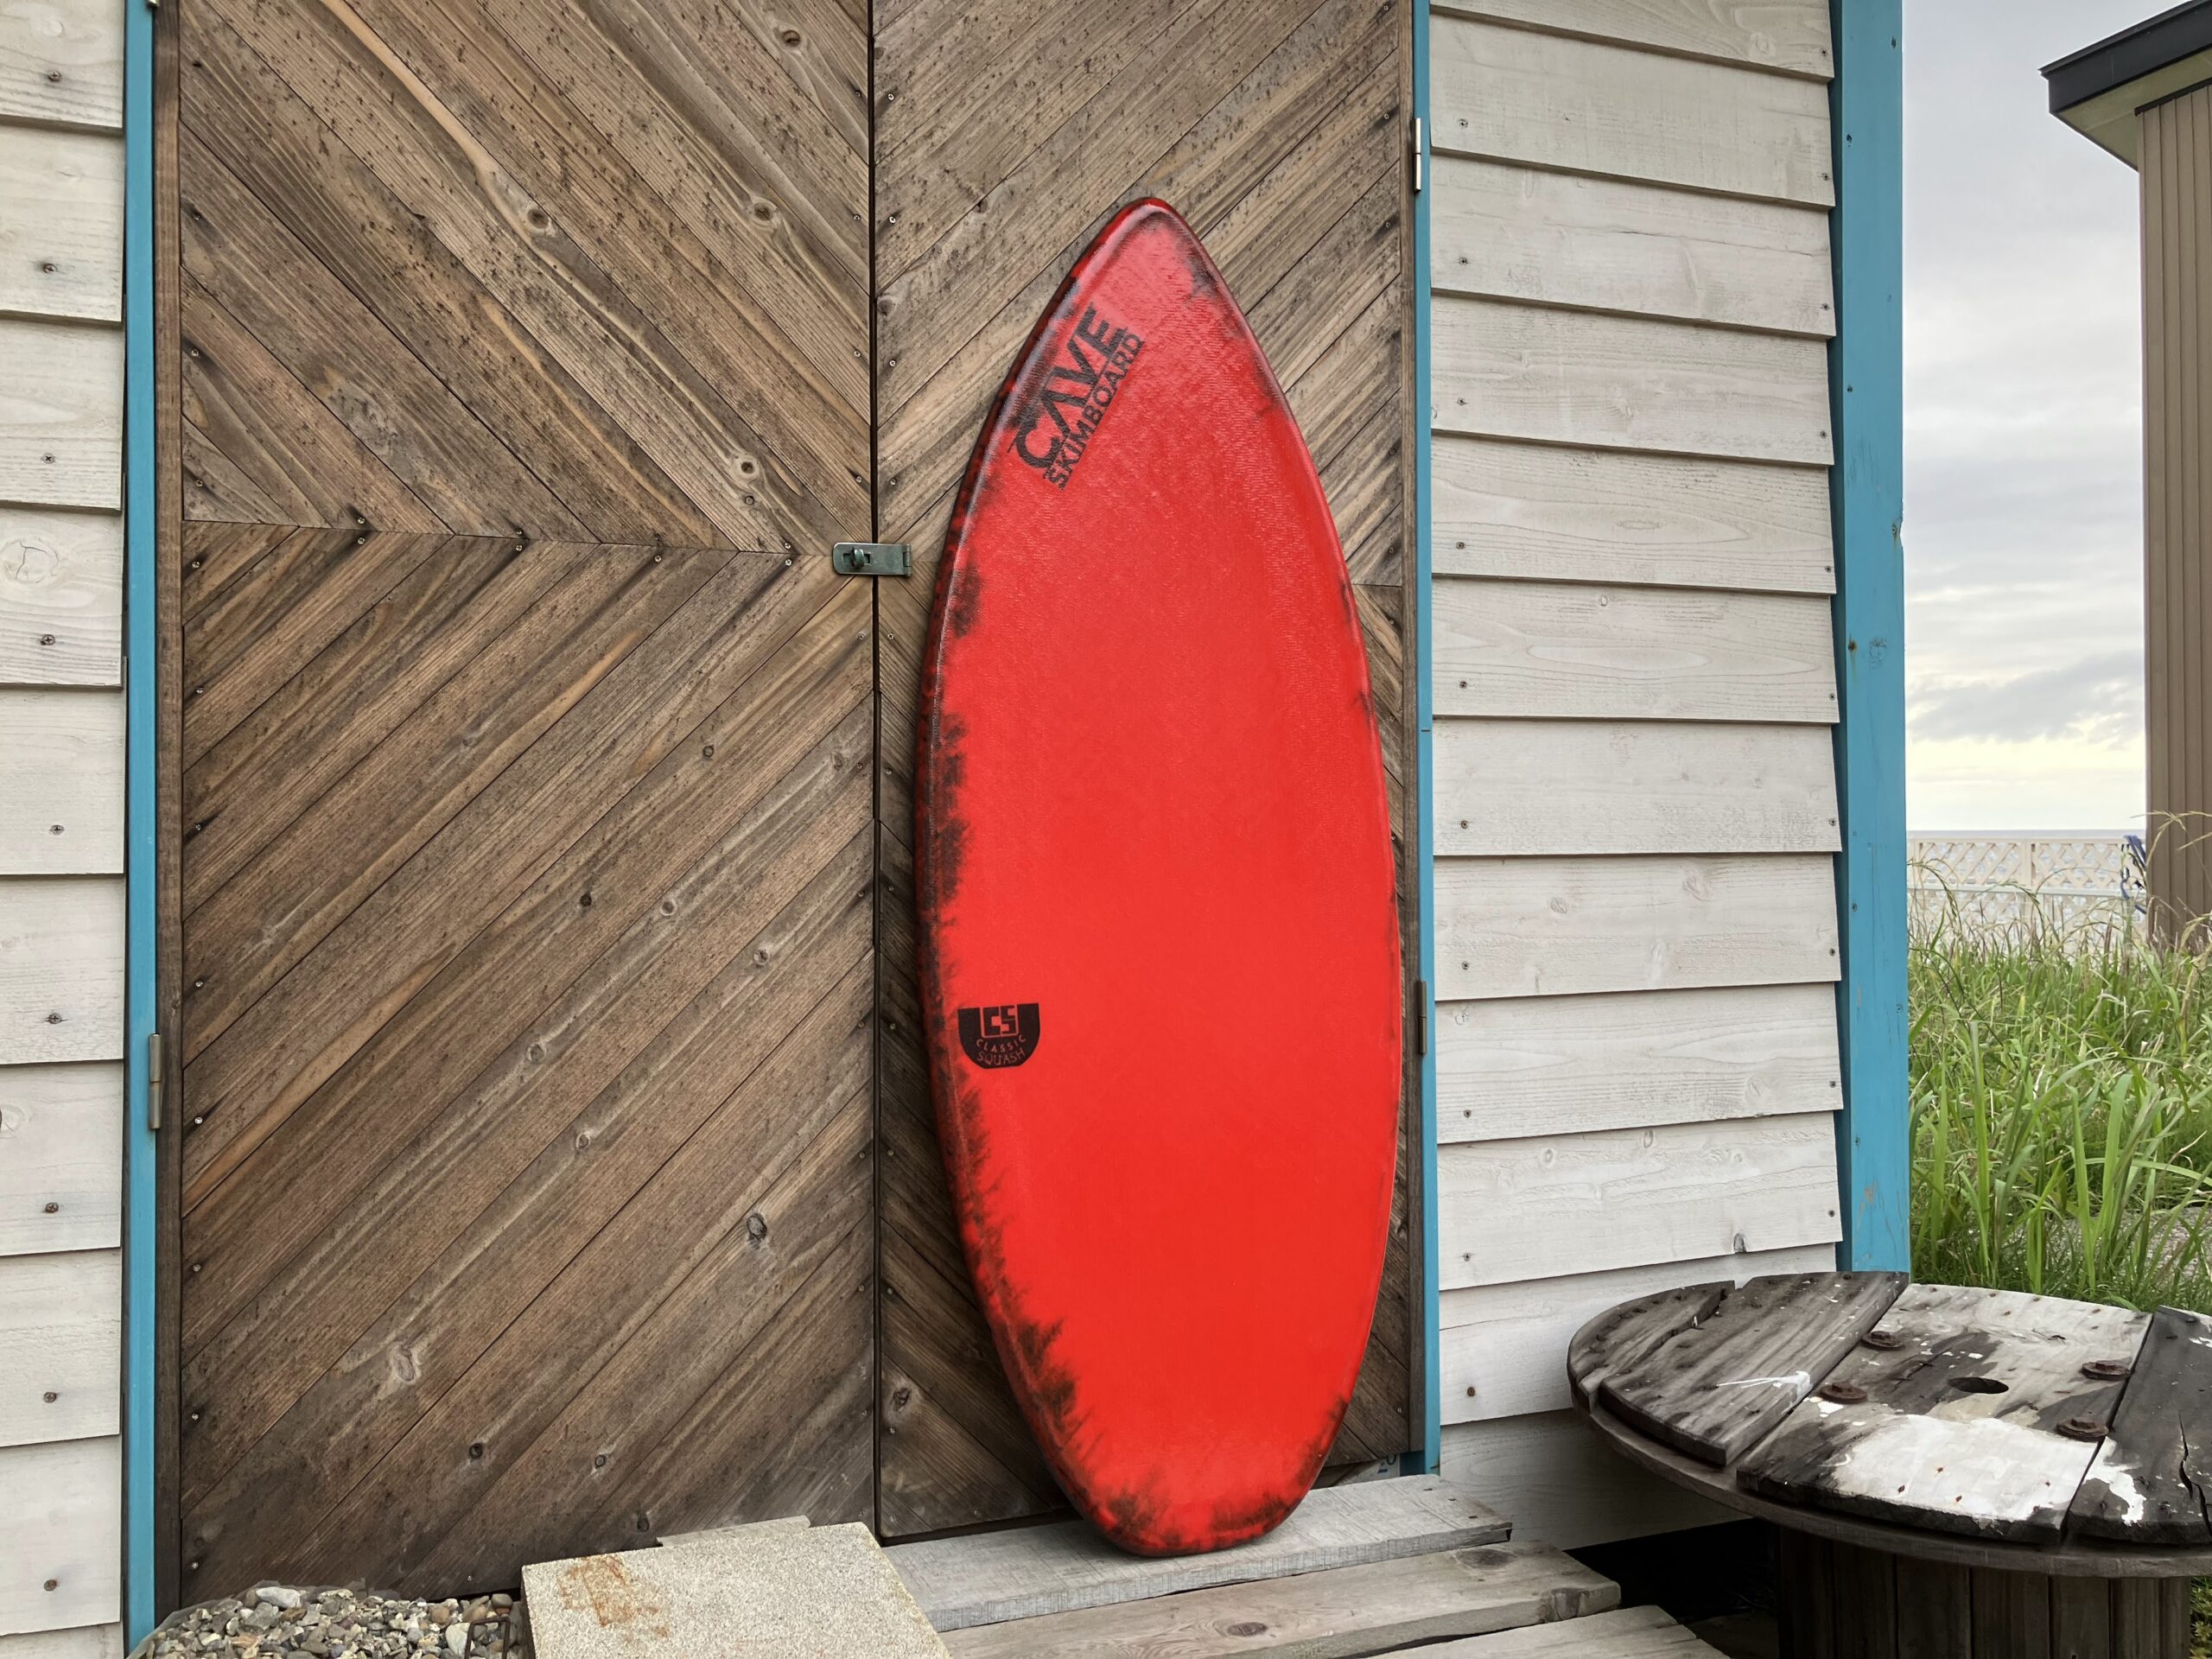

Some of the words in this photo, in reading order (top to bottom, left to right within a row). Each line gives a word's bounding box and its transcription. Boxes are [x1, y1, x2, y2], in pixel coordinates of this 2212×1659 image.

[1013, 302, 1128, 468] CAVE
[1043, 334, 1146, 490] SKIMBOARD
[976, 1034, 1027, 1053] CLASSIC
[976, 1047, 1027, 1065] SQUASH
